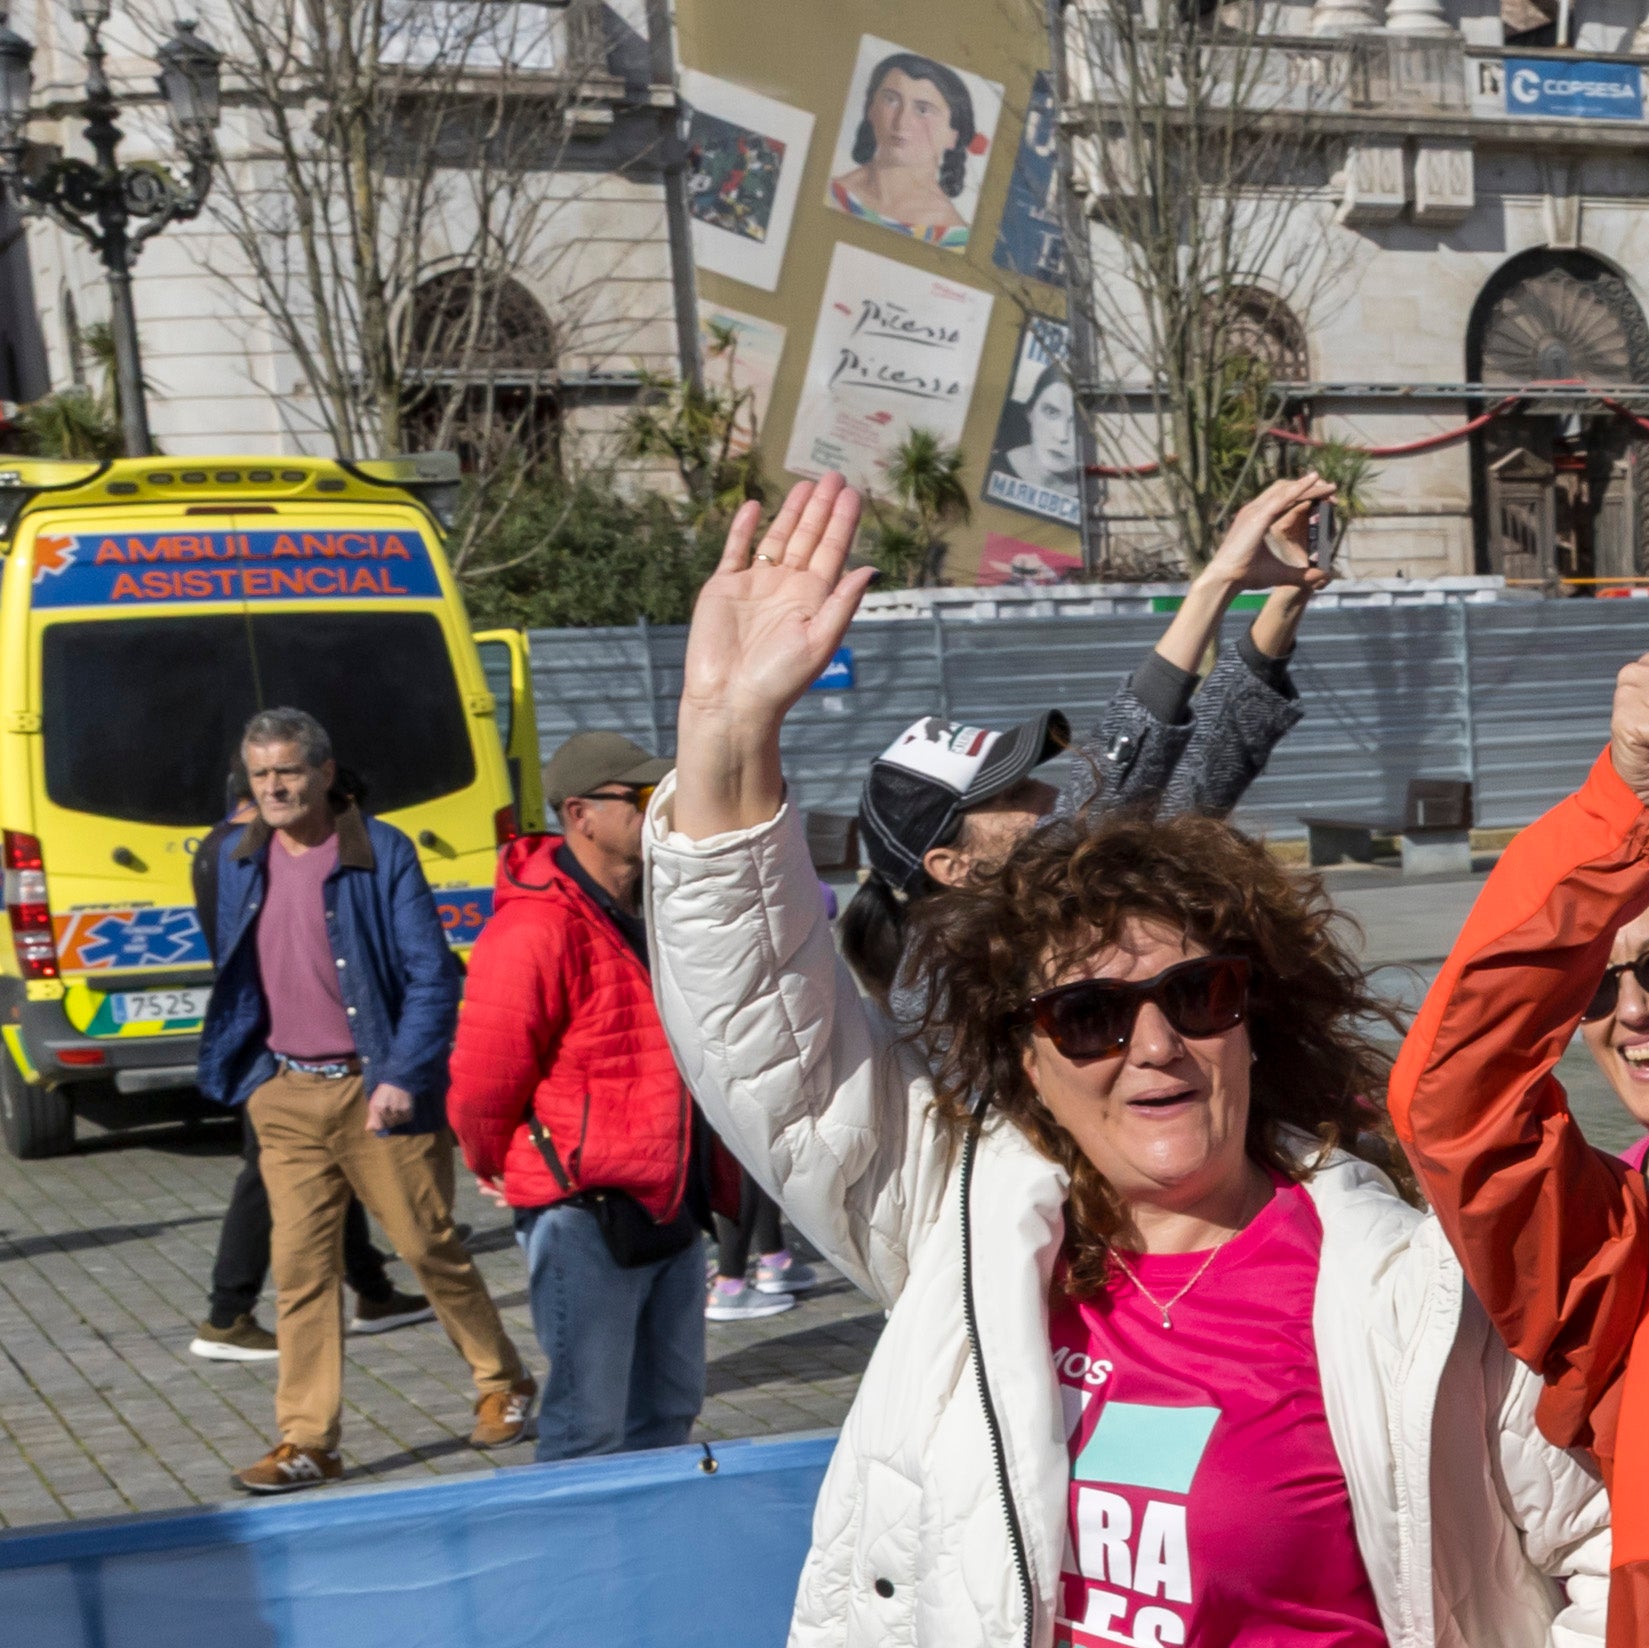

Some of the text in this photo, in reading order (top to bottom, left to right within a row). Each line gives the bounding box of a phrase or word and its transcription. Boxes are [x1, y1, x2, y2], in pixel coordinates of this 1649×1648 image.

[94, 533, 412, 566] AMBULANCIA
[110, 567, 408, 600] ASISTENCIAL
[132, 992, 196, 1019] 7525
